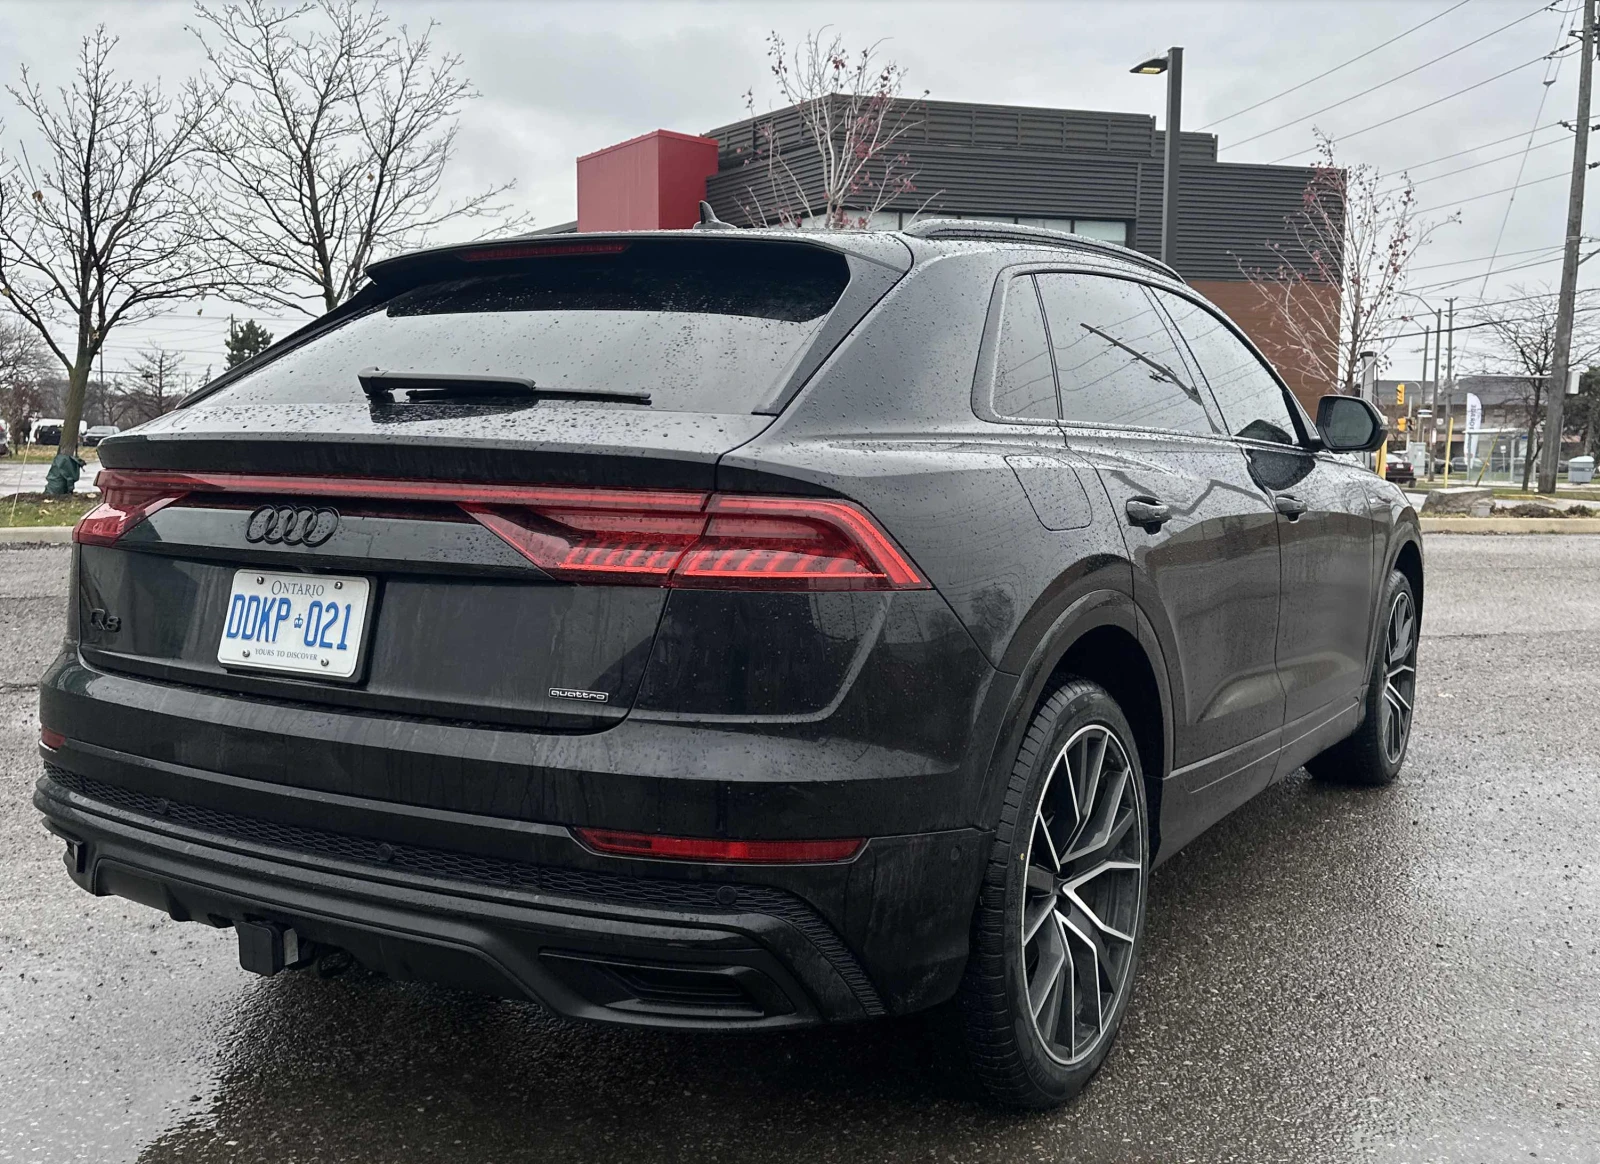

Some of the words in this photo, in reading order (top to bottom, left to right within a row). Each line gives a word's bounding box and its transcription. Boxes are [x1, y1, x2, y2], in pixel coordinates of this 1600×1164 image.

[226, 594, 292, 643] DDKP
[304, 600, 352, 650] 021
[255, 648, 275, 657] YOURS
[276, 650, 286, 658] TO
[286, 651, 318, 661] DISCOVER
[551, 690, 605, 700] quattro
